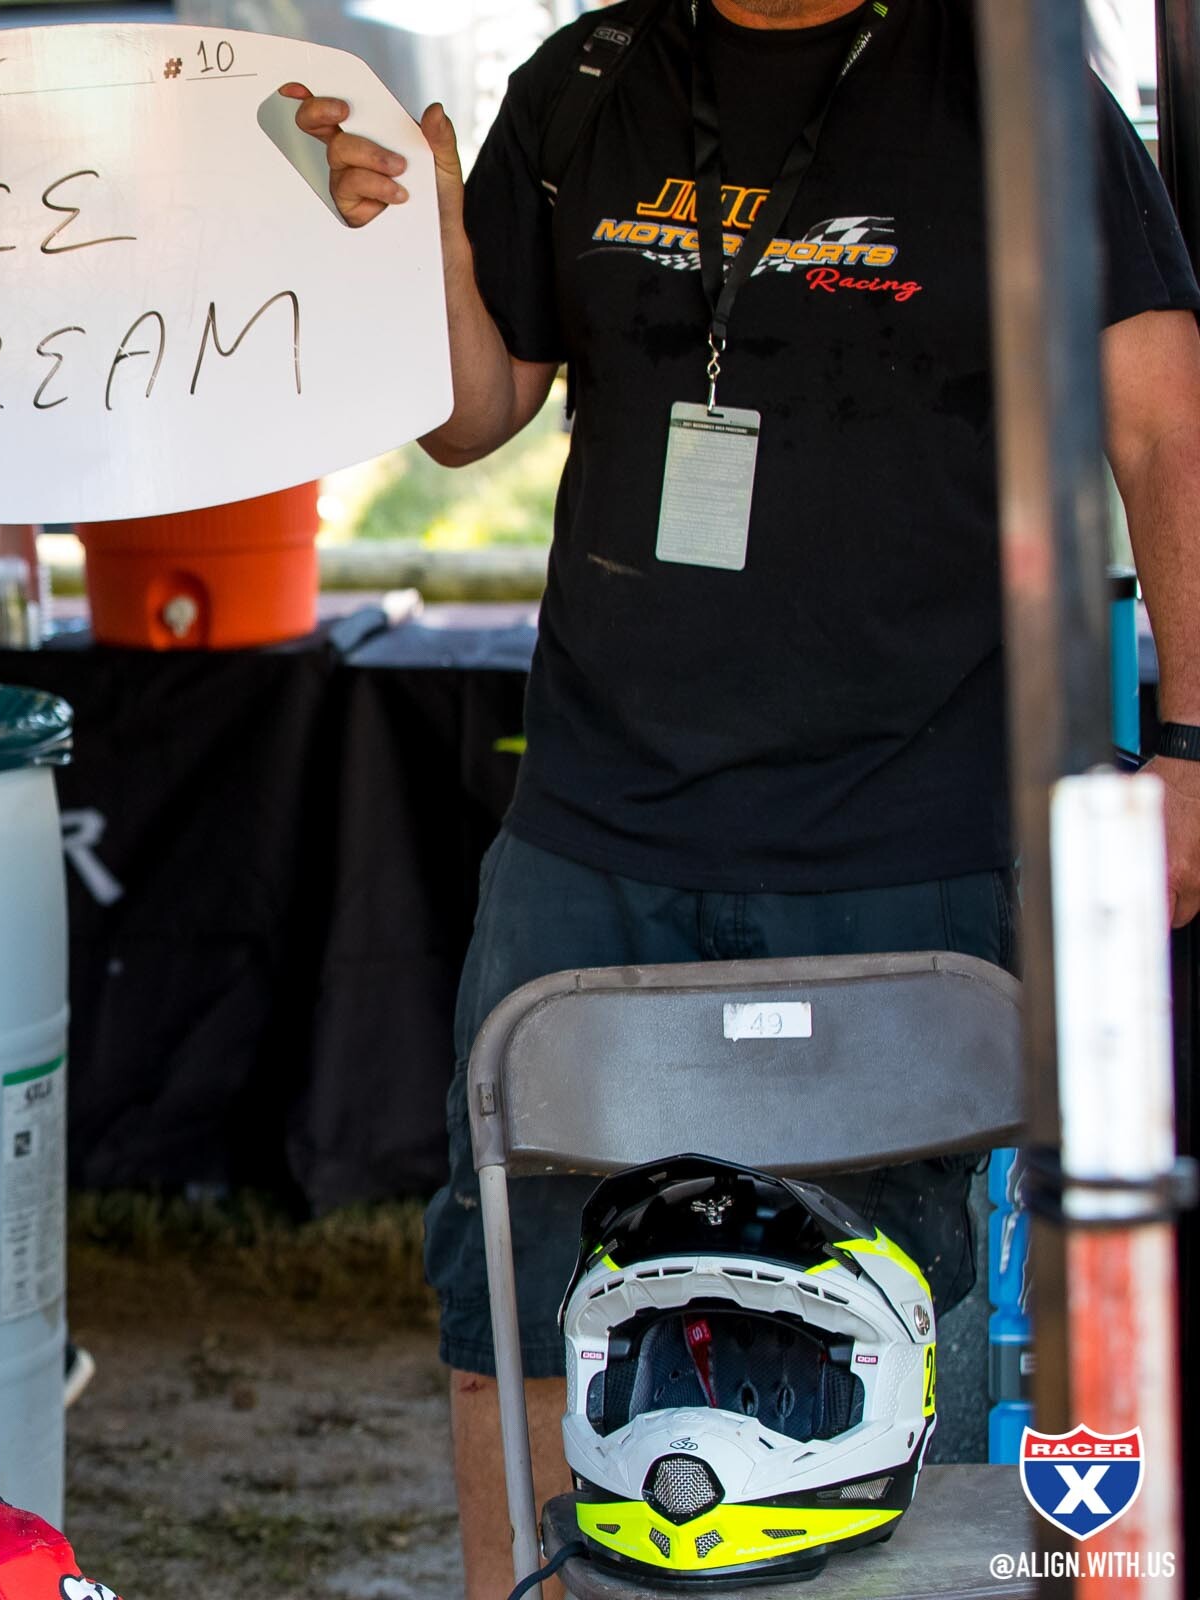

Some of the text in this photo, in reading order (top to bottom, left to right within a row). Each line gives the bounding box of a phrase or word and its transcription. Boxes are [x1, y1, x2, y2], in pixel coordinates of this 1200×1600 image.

[197, 40, 236, 73] 10
[804, 266, 923, 302] Racing
[924, 1346, 936, 1408] 2
